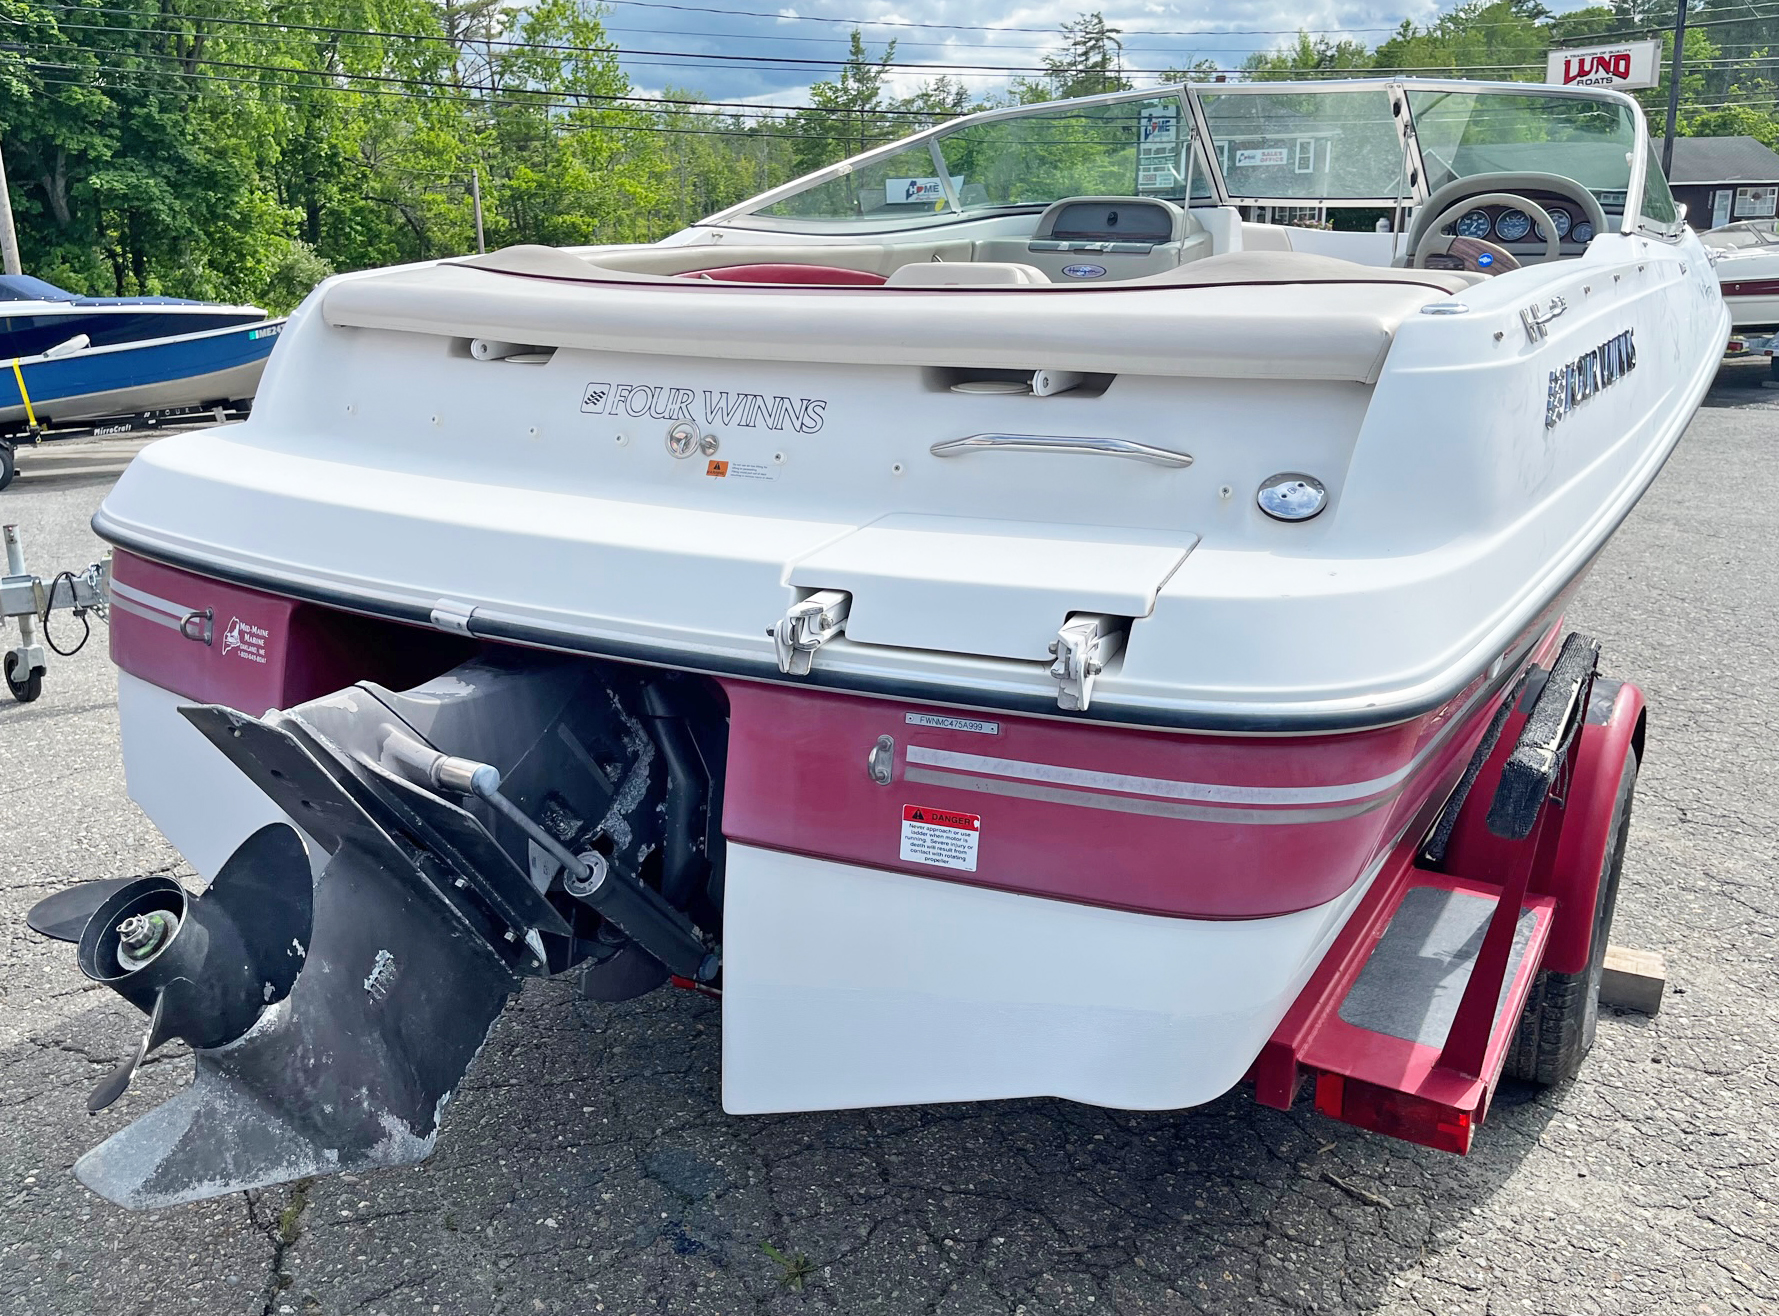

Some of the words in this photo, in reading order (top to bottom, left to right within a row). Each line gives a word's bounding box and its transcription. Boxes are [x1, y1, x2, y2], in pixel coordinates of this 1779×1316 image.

[1563, 53, 1631, 85] LUND
[1577, 77, 1613, 86] BOATS
[608, 384, 697, 422] FOUR
[703, 390, 828, 435] WINNS
[93, 424, 132, 436] MirroCraft
[919, 716, 983, 731] FWNMC475A999
[932, 813, 971, 826] DANGER
[909, 823, 925, 831] Never
[905, 835, 927, 843] running.
[950, 841, 966, 850] injury
[925, 856, 951, 864] propeller.
[944, 854, 967, 862] rotating
